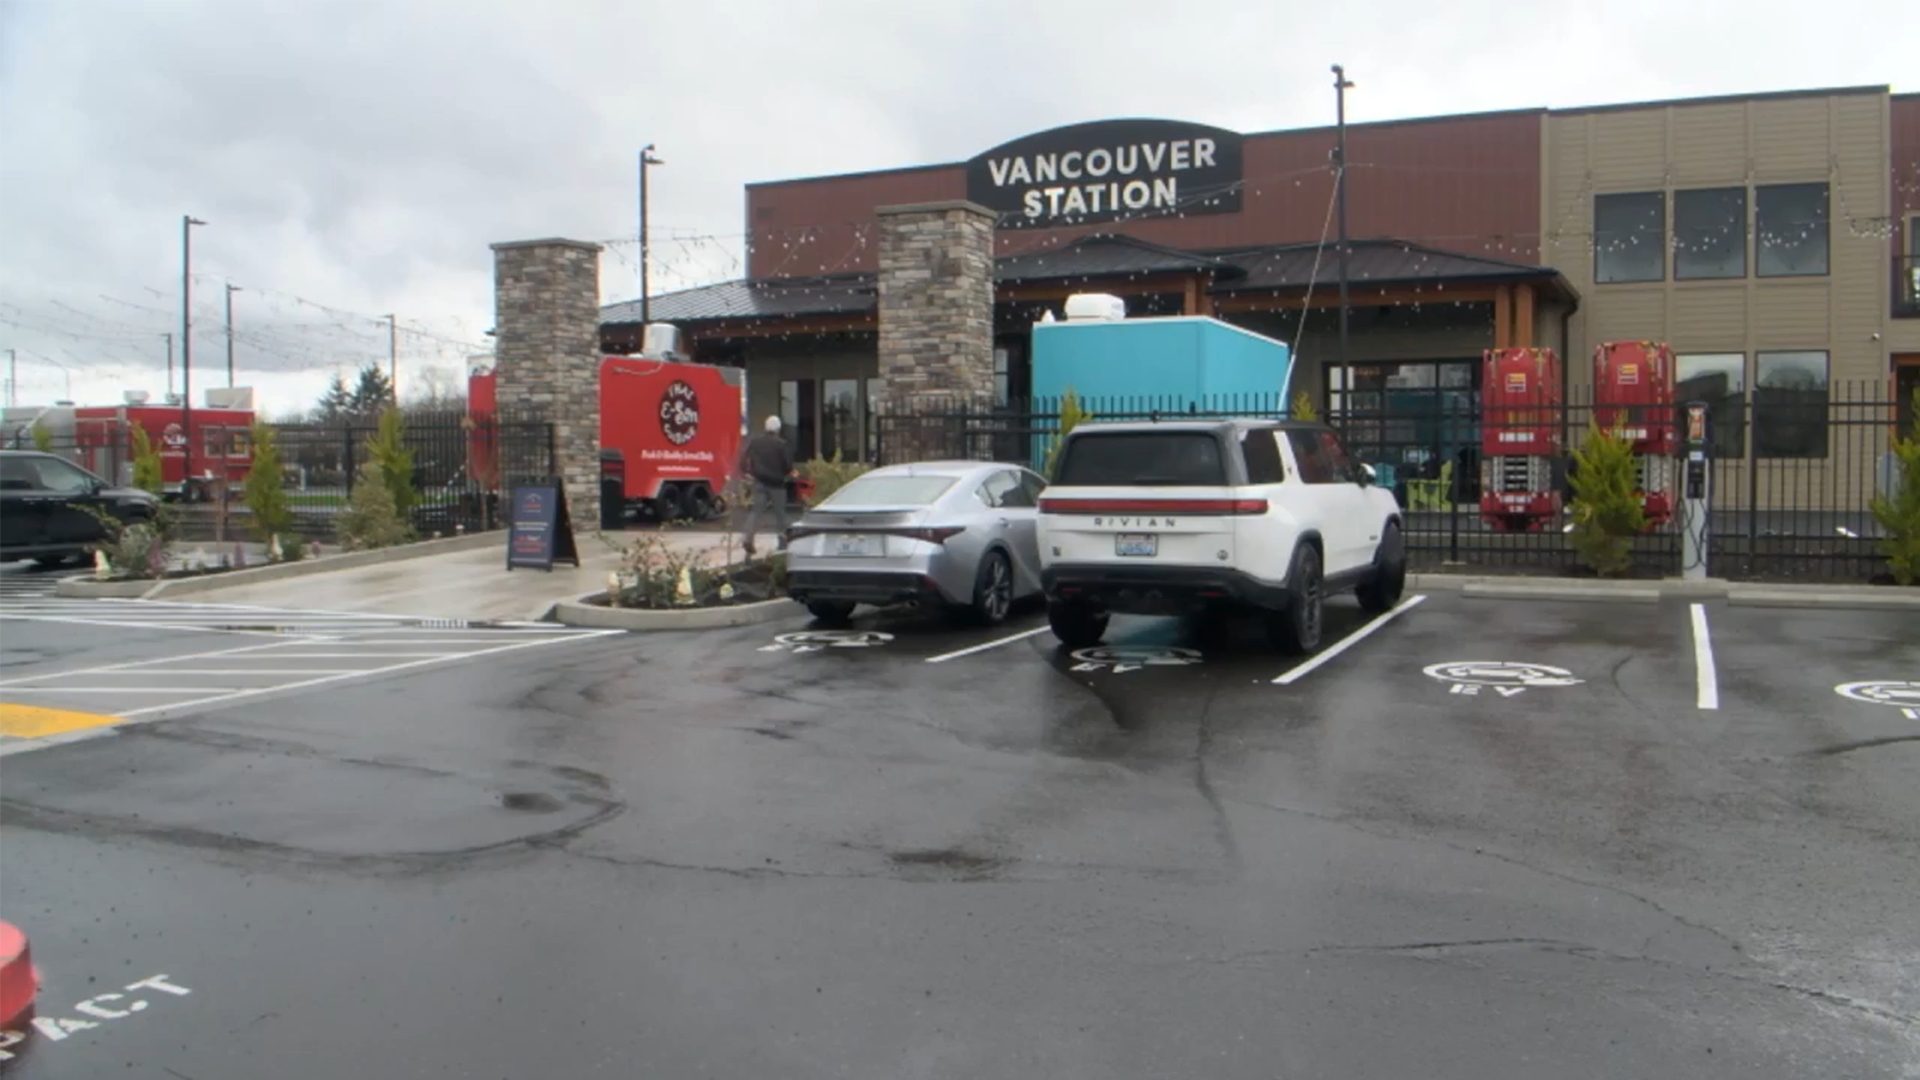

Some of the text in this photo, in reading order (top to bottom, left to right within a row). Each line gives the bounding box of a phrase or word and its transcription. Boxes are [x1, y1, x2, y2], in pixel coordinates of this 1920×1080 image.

[988, 138, 1216, 187] VANCOUVER
[1024, 178, 1177, 218] STATION
[1094, 517, 1176, 528] RIVIAN
[1448, 683, 1527, 697] EV
